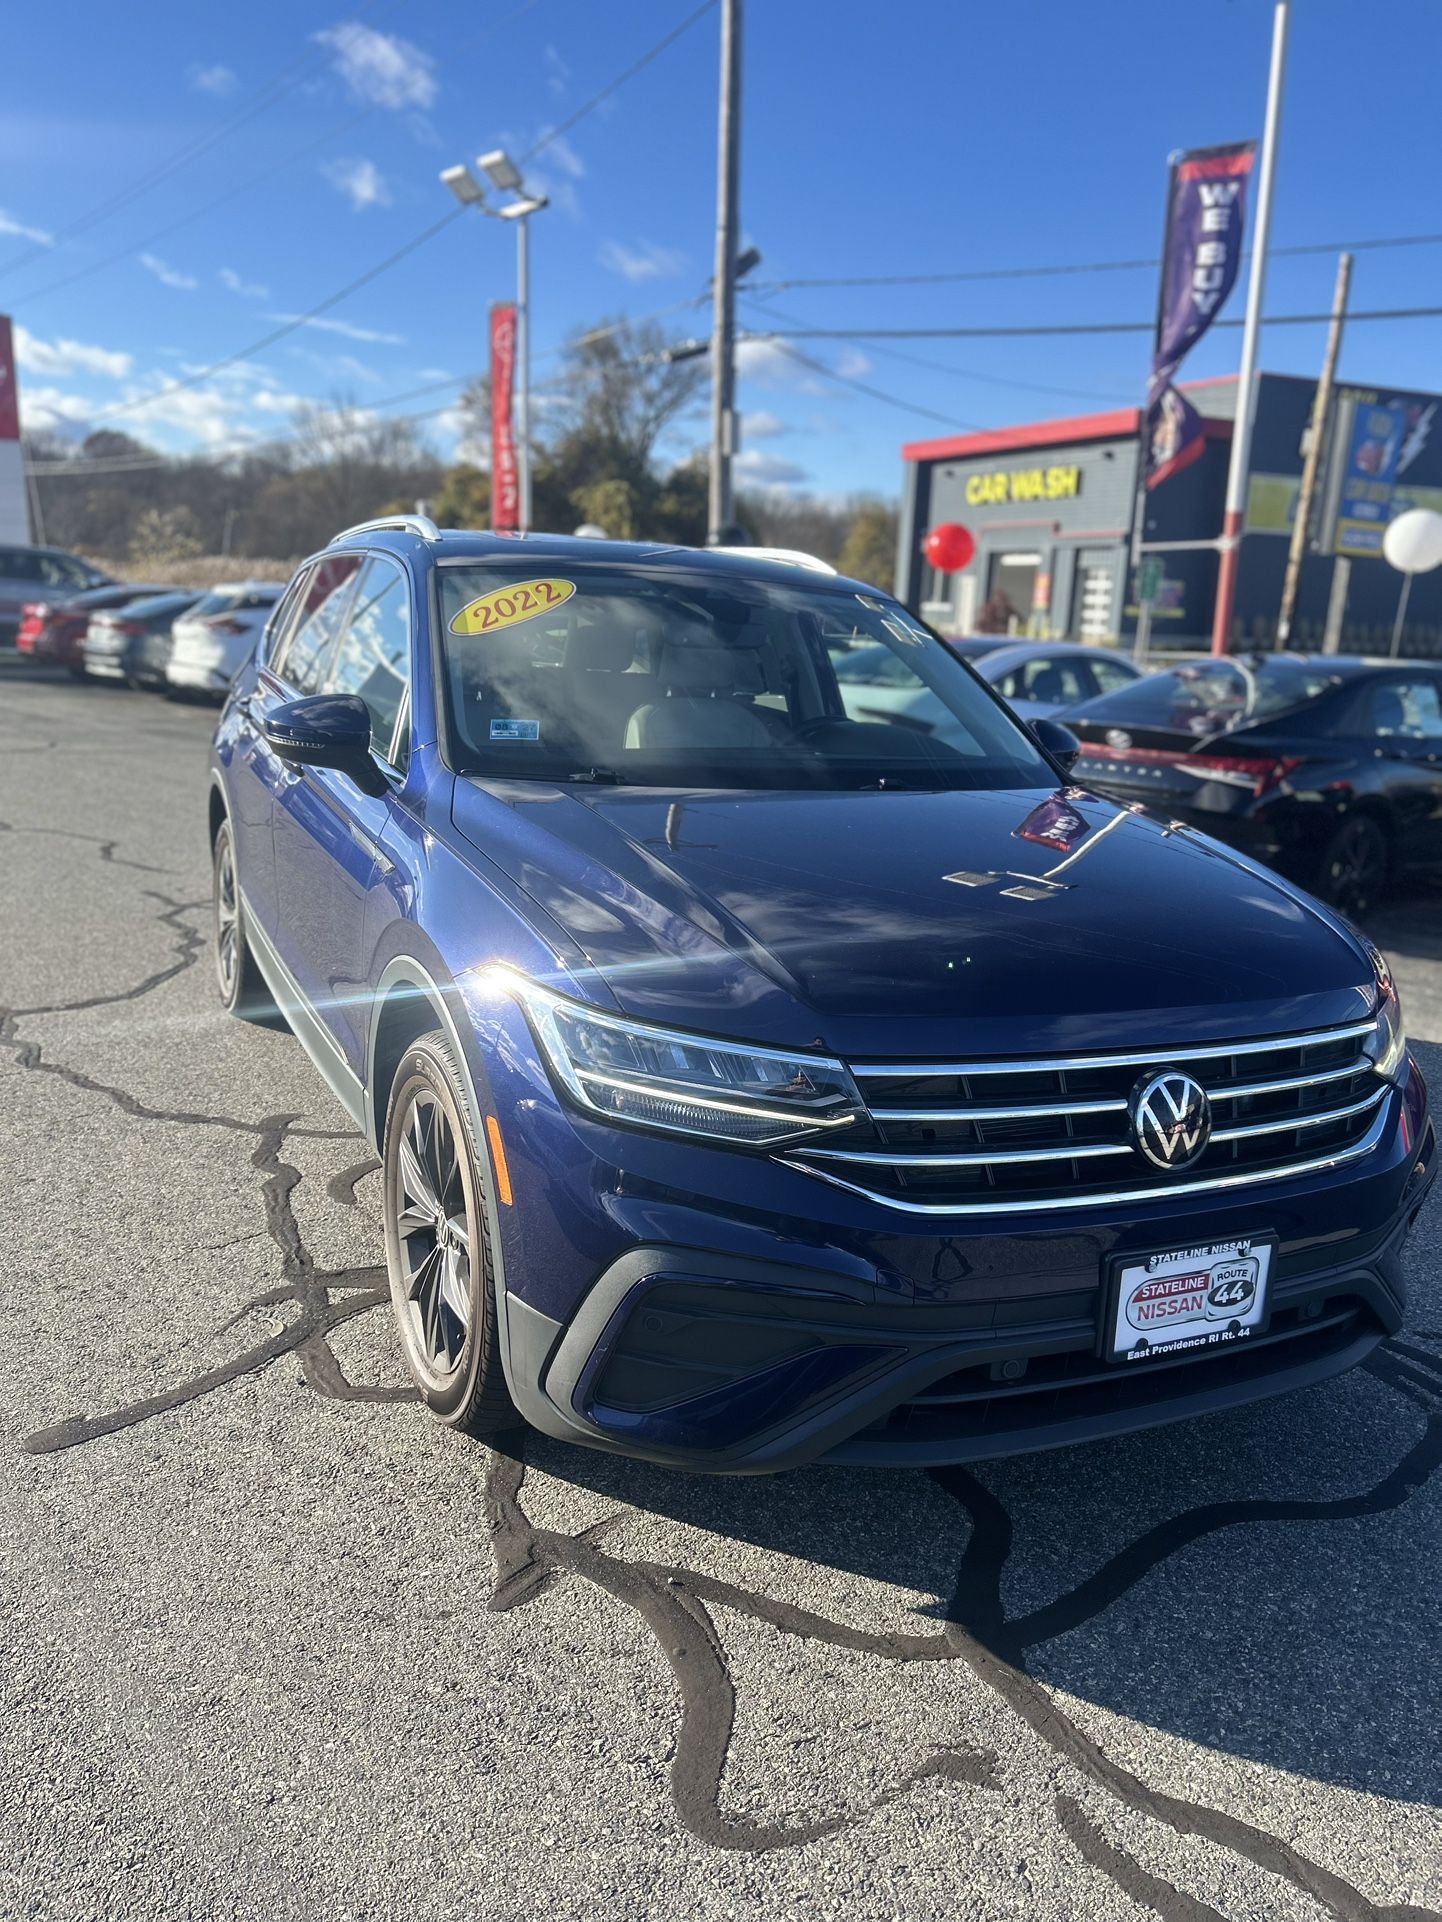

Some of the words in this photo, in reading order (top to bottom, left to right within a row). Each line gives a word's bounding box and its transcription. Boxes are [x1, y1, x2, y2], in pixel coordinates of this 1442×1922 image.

[1198, 181, 1240, 232] WE
[1191, 242, 1226, 314] BUY
[965, 471, 1008, 507] CAR
[1010, 465, 1080, 501] WASH
[473, 583, 562, 629] 2022
[1149, 1247, 1209, 1265] STATELINE
[1211, 1240, 1251, 1255] NISSAN
[1142, 1277, 1205, 1298] STATELINE
[1217, 1269, 1249, 1282] ROUTE
[1214, 1281, 1244, 1303] 44
[1137, 1295, 1203, 1321] NISSAN
[1127, 1347, 1150, 1360] East
[1152, 1338, 1206, 1354] Providence
[1208, 1333, 1219, 1343] RI
[1221, 1331, 1235, 1341] Rt.
[1238, 1328, 1250, 1337] 44
